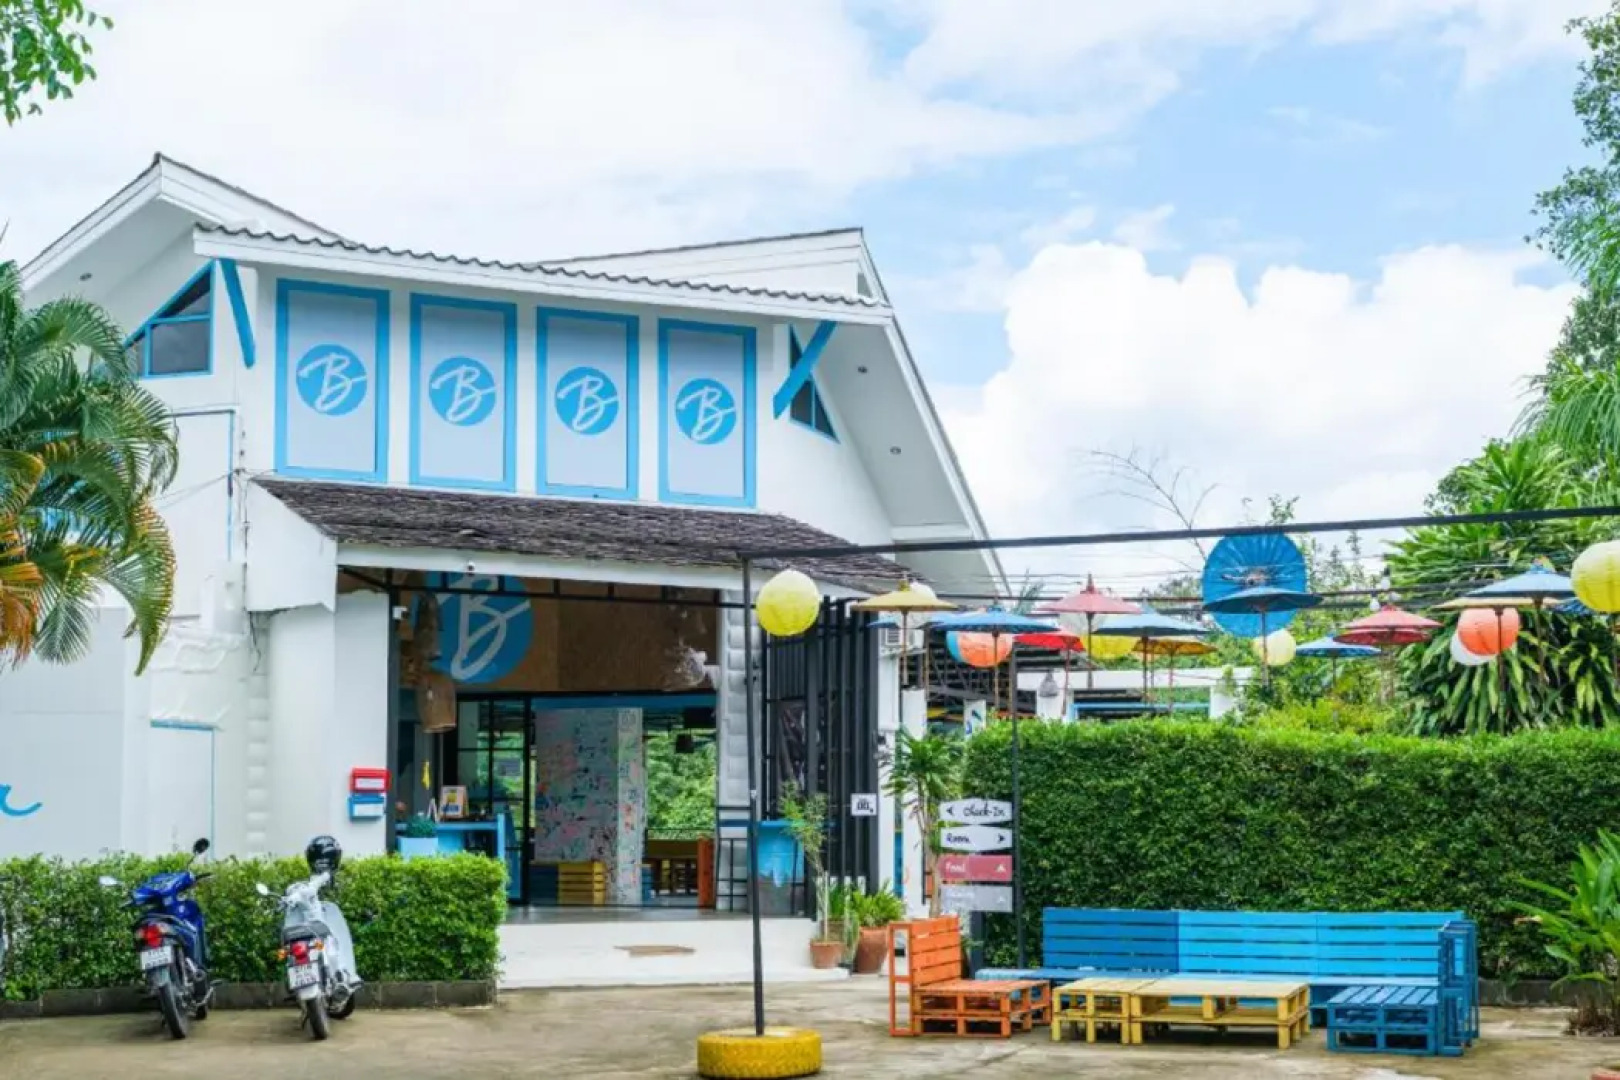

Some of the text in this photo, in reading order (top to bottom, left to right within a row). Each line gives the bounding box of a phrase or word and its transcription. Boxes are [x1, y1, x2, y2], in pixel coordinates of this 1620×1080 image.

[299, 353, 367, 412] B
[431, 365, 496, 422] B
[557, 375, 618, 431] B
[677, 386, 736, 440] B
